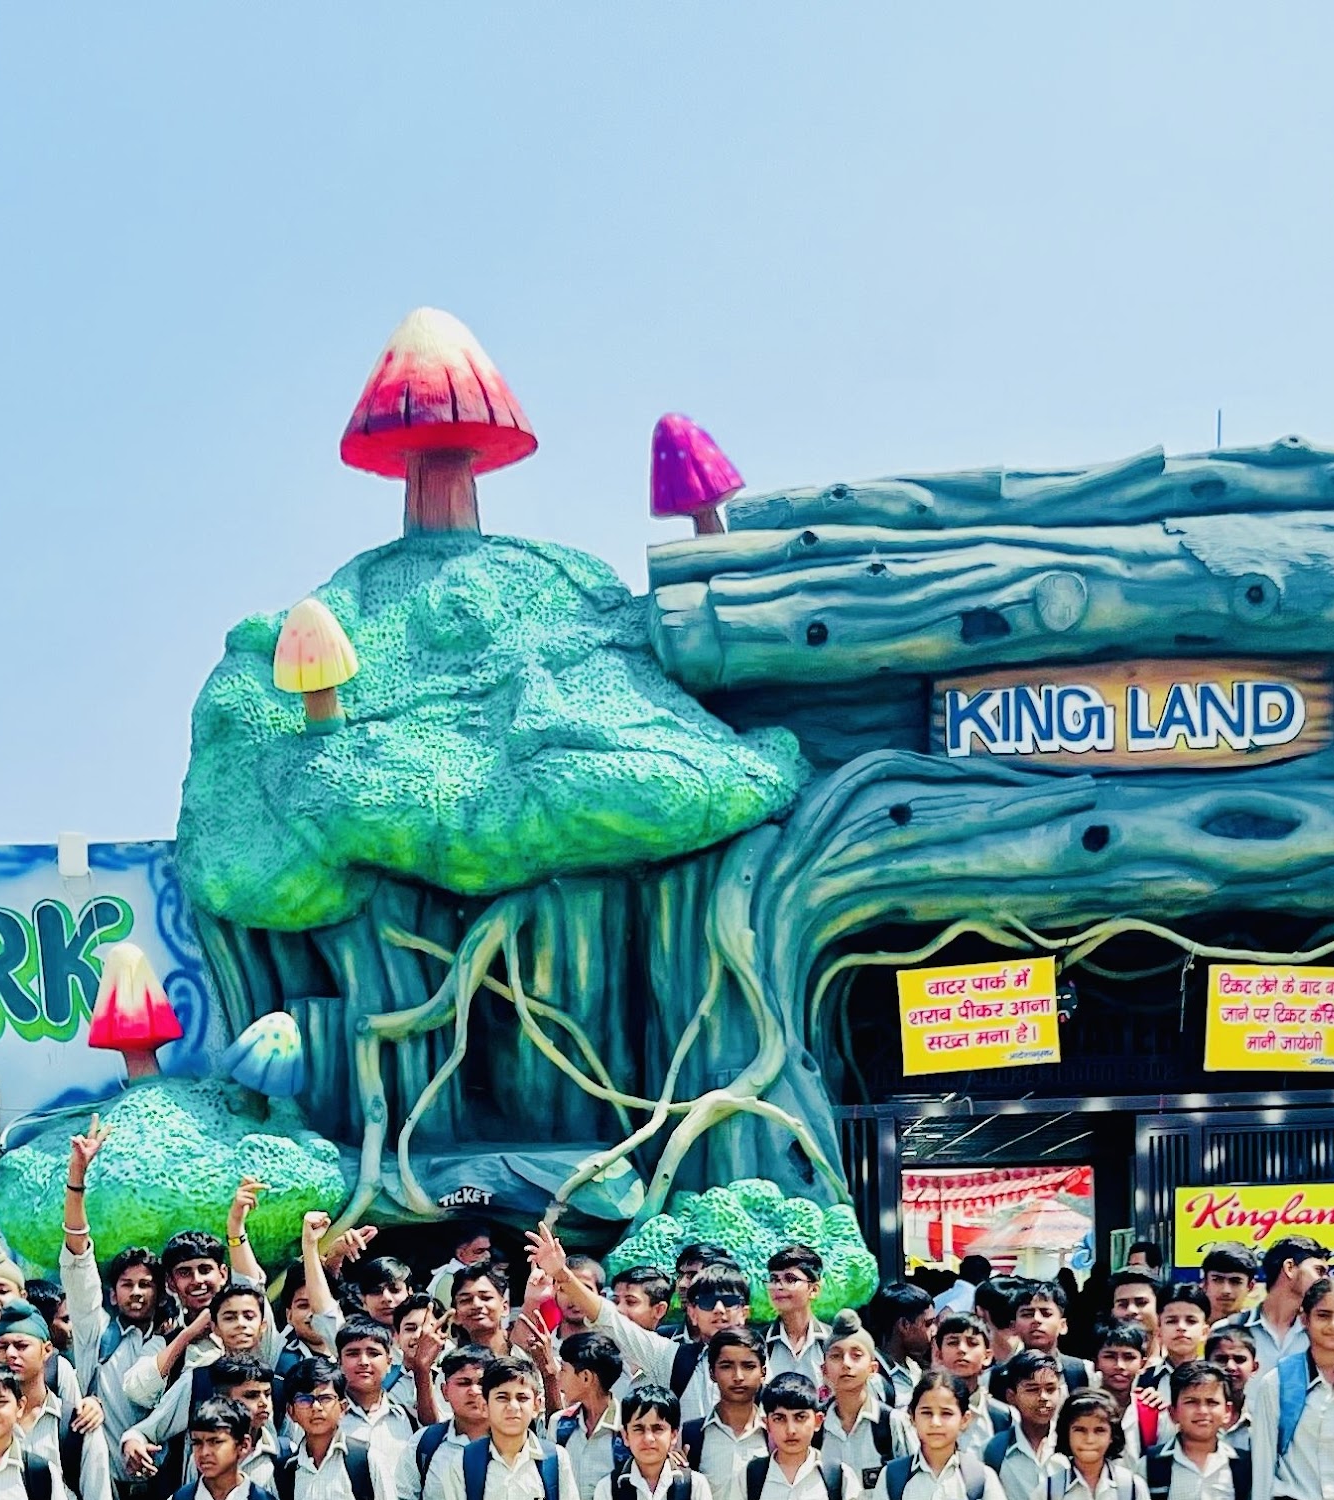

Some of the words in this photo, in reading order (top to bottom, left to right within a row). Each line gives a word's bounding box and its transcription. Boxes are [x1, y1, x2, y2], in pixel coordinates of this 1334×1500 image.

[945, 686, 1114, 757] KING
[1127, 681, 1306, 753] LAND
[927, 979, 966, 996] वाटर
[972, 969, 1008, 992] पार्क
[1014, 967, 1031, 988] में
[1219, 972, 1252, 994] टिकट
[1256, 975, 1278, 995] लेने
[1282, 976, 1295, 994] के
[1299, 979, 1322, 995] बाद
[908, 1006, 951, 1025] शराब
[957, 999, 1005, 1020] पीकर
[1008, 998, 1052, 1017] आना
[1221, 1003, 1250, 1022] जाने
[1253, 1008, 1271, 1022] पर
[1273, 1001, 1307, 1023] टिकट
[926, 1033, 969, 1051] सख्त
[975, 1028, 1010, 1045] मना
[1246, 1030, 1276, 1050] मानी
[438, 1187, 493, 1207] TICKET
